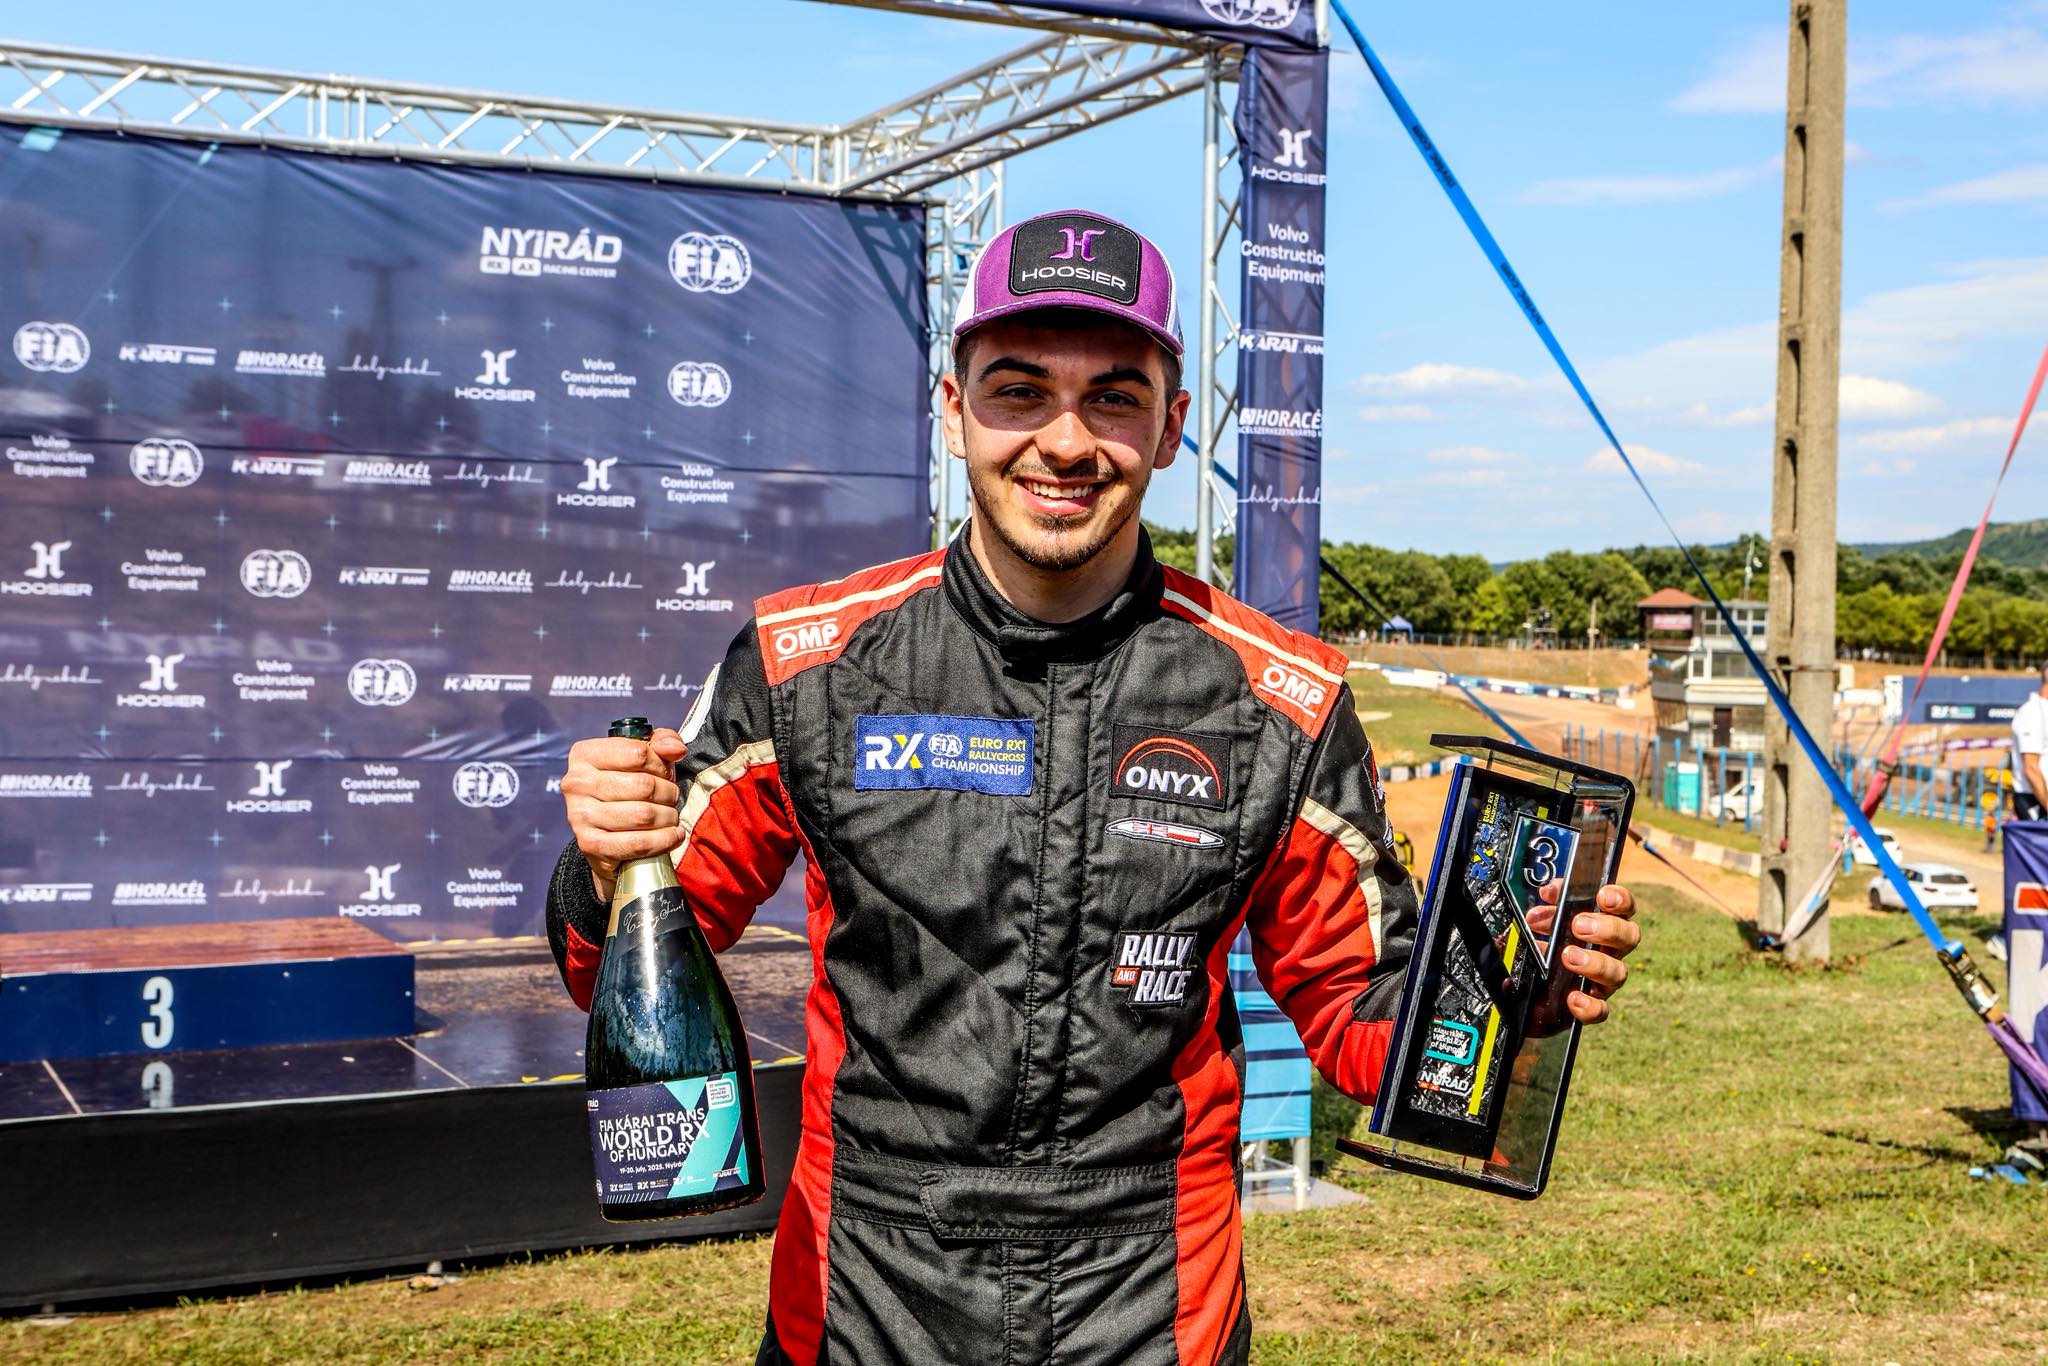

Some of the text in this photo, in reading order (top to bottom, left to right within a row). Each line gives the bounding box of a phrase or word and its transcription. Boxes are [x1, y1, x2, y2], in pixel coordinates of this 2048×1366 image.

[1268, 223, 1309, 243] Volvo
[480, 226, 622, 263] NYIRÁD
[1241, 240, 1325, 266] Constructio
[1021, 266, 1127, 292] HOOSIER
[1248, 261, 1325, 286] Equipment
[582, 358, 615, 371] Volvo
[561, 370, 637, 386] Construction
[455, 386, 536, 402] HOOSIER
[567, 384, 631, 399] Equipment
[1255, 408, 1321, 429] HORACÉ
[681, 464, 714, 477] Volvo
[660, 476, 735, 491] Construction
[557, 493, 636, 508] HOOSIER
[667, 489, 729, 504] Equipment
[145, 549, 184, 563] Volvo
[1, 581, 93, 597] HOOSIER
[656, 599, 733, 612] HOOSIER
[775, 623, 839, 656] OMP
[256, 660, 293, 673] Volvo
[232, 672, 316, 687] Construction
[239, 686, 309, 701] Equipment
[1263, 667, 1324, 708] OMP
[116, 694, 206, 709] HOOSIER
[864, 733, 925, 770] RX
[969, 737, 1026, 751] EURO RX1
[969, 750, 1026, 762] RALLYCROSS
[363, 764, 399, 777] Volvo
[932, 758, 1026, 776] CHAMPIONSHIP
[341, 777, 420, 791] Construction
[1126, 766, 1212, 799] ONYX
[348, 791, 413, 804] Equipment
[226, 800, 312, 813] HOOSIER
[1524, 836, 1560, 888] 3
[468, 868, 502, 880] Volvo
[447, 880, 523, 894] Construction
[453, 893, 517, 907] Equipment
[339, 904, 421, 917] HOOSIER
[1120, 934, 1194, 966] RALLY
[1117, 969, 1137, 982] AND
[1135, 970, 1192, 1002] RACE
[141, 976, 175, 1049] 3
[600, 1108, 705, 1132] FIA KÁRAI TRANS
[599, 1119, 710, 1151] WORLD RX
[610, 1141, 694, 1163] OF HUNGARY
